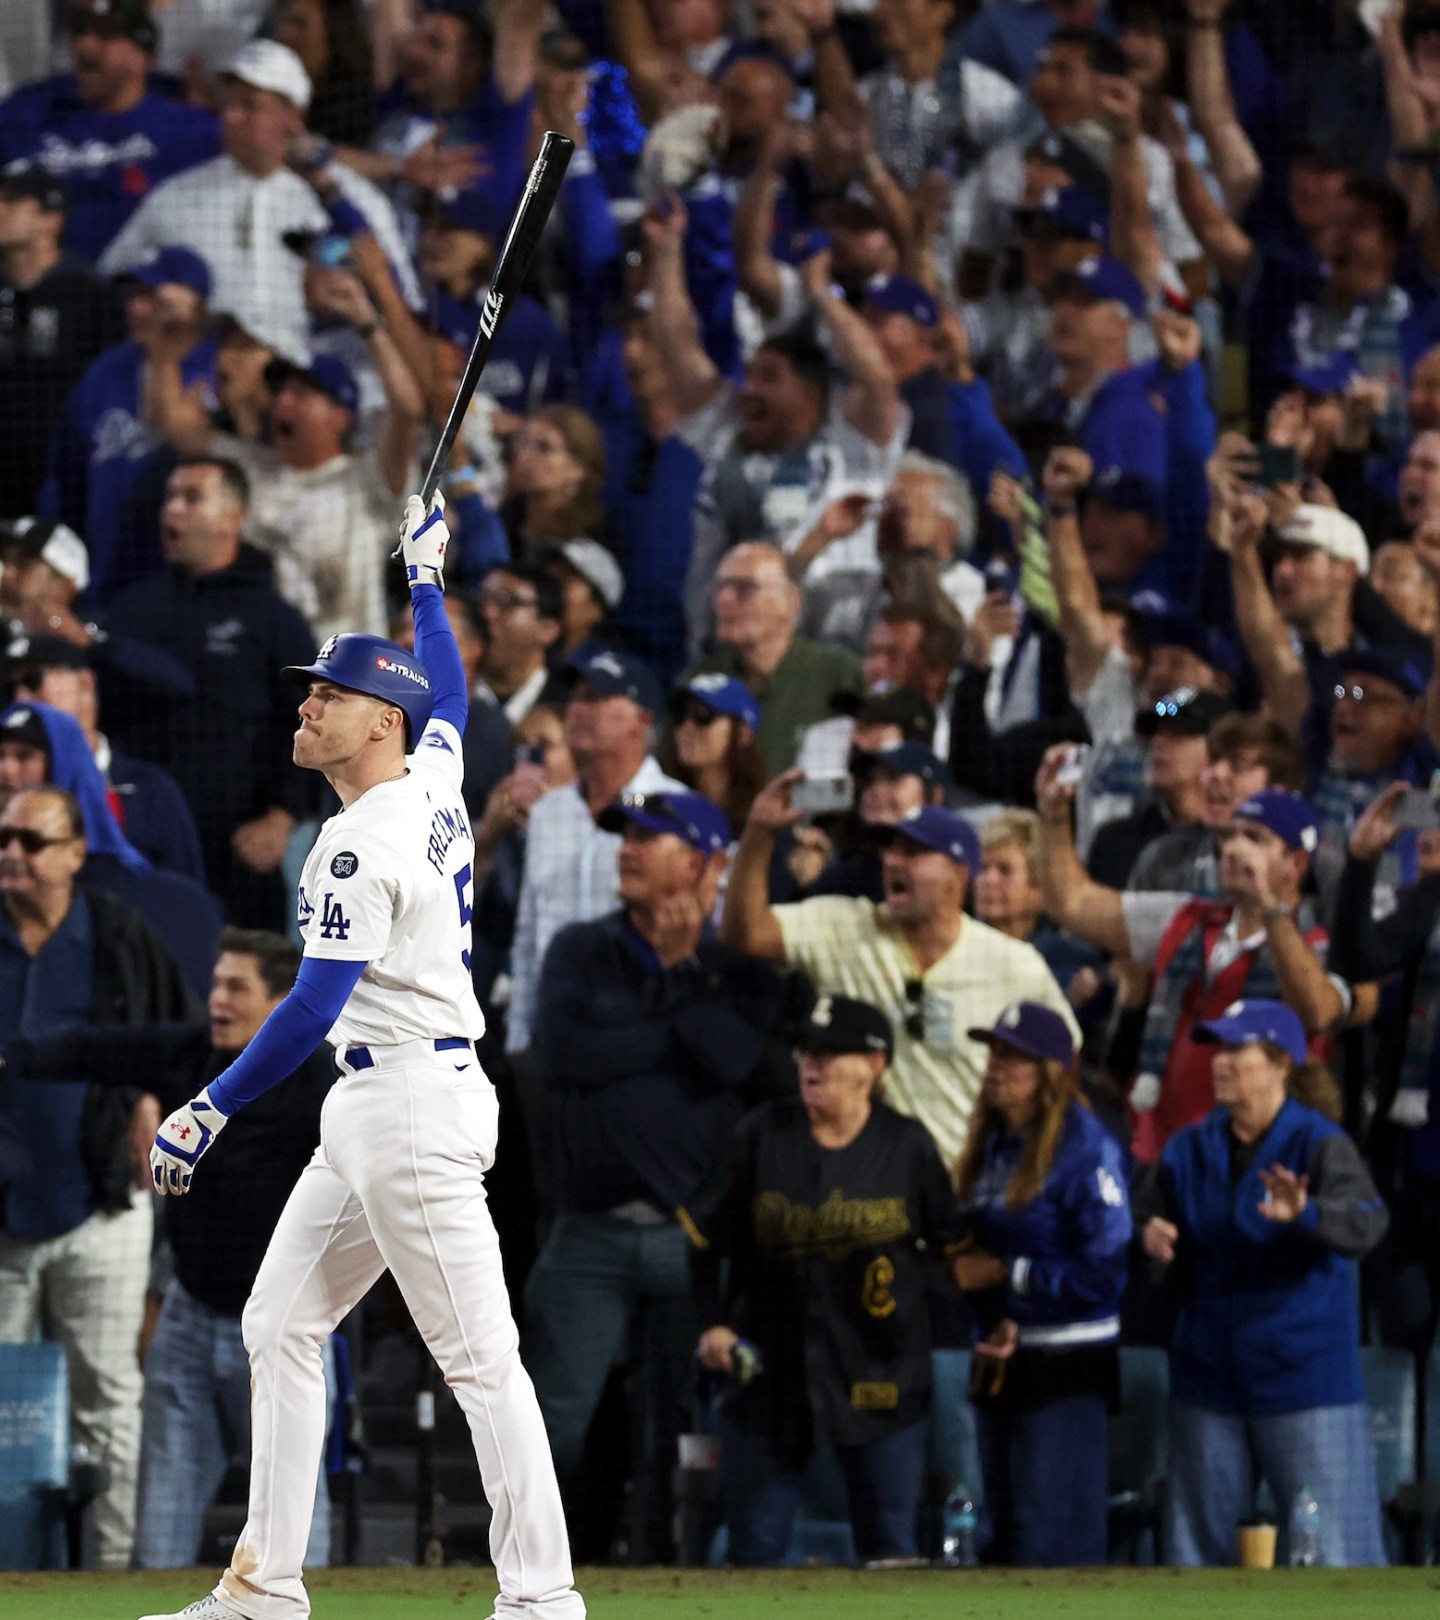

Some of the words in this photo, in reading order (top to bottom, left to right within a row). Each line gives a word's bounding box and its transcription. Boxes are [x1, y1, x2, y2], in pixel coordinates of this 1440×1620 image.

[490, 292, 504, 332] marucci
[317, 634, 339, 659] LA
[391, 662, 429, 690] STRAUSS
[427, 807, 474, 876] FREEMA
[334, 861, 353, 875] 34
[320, 893, 351, 940] LA
